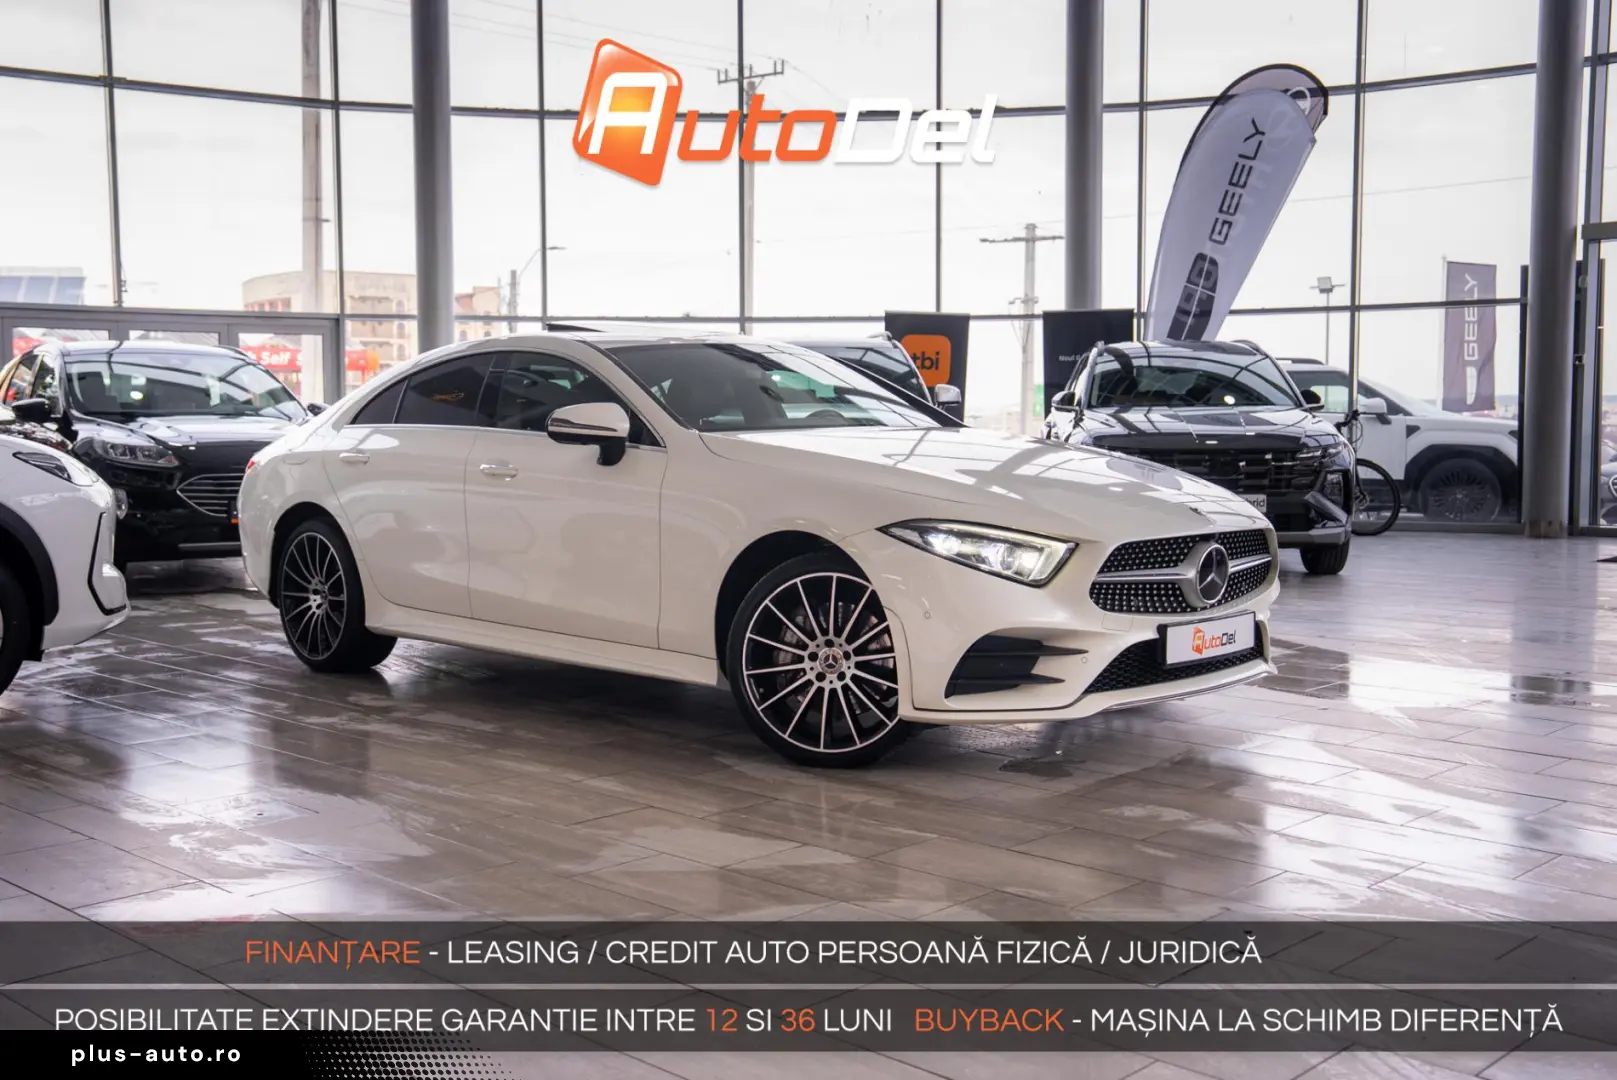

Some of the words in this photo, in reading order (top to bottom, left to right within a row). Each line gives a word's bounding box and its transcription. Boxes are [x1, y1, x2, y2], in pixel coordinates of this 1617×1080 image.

[1208, 117, 1266, 246] GEELY
[1463, 273, 1479, 361] GEELY
[259, 351, 291, 366] Self
[910, 351, 941, 370] tbi
[1192, 628, 1237, 653] AutoDel
